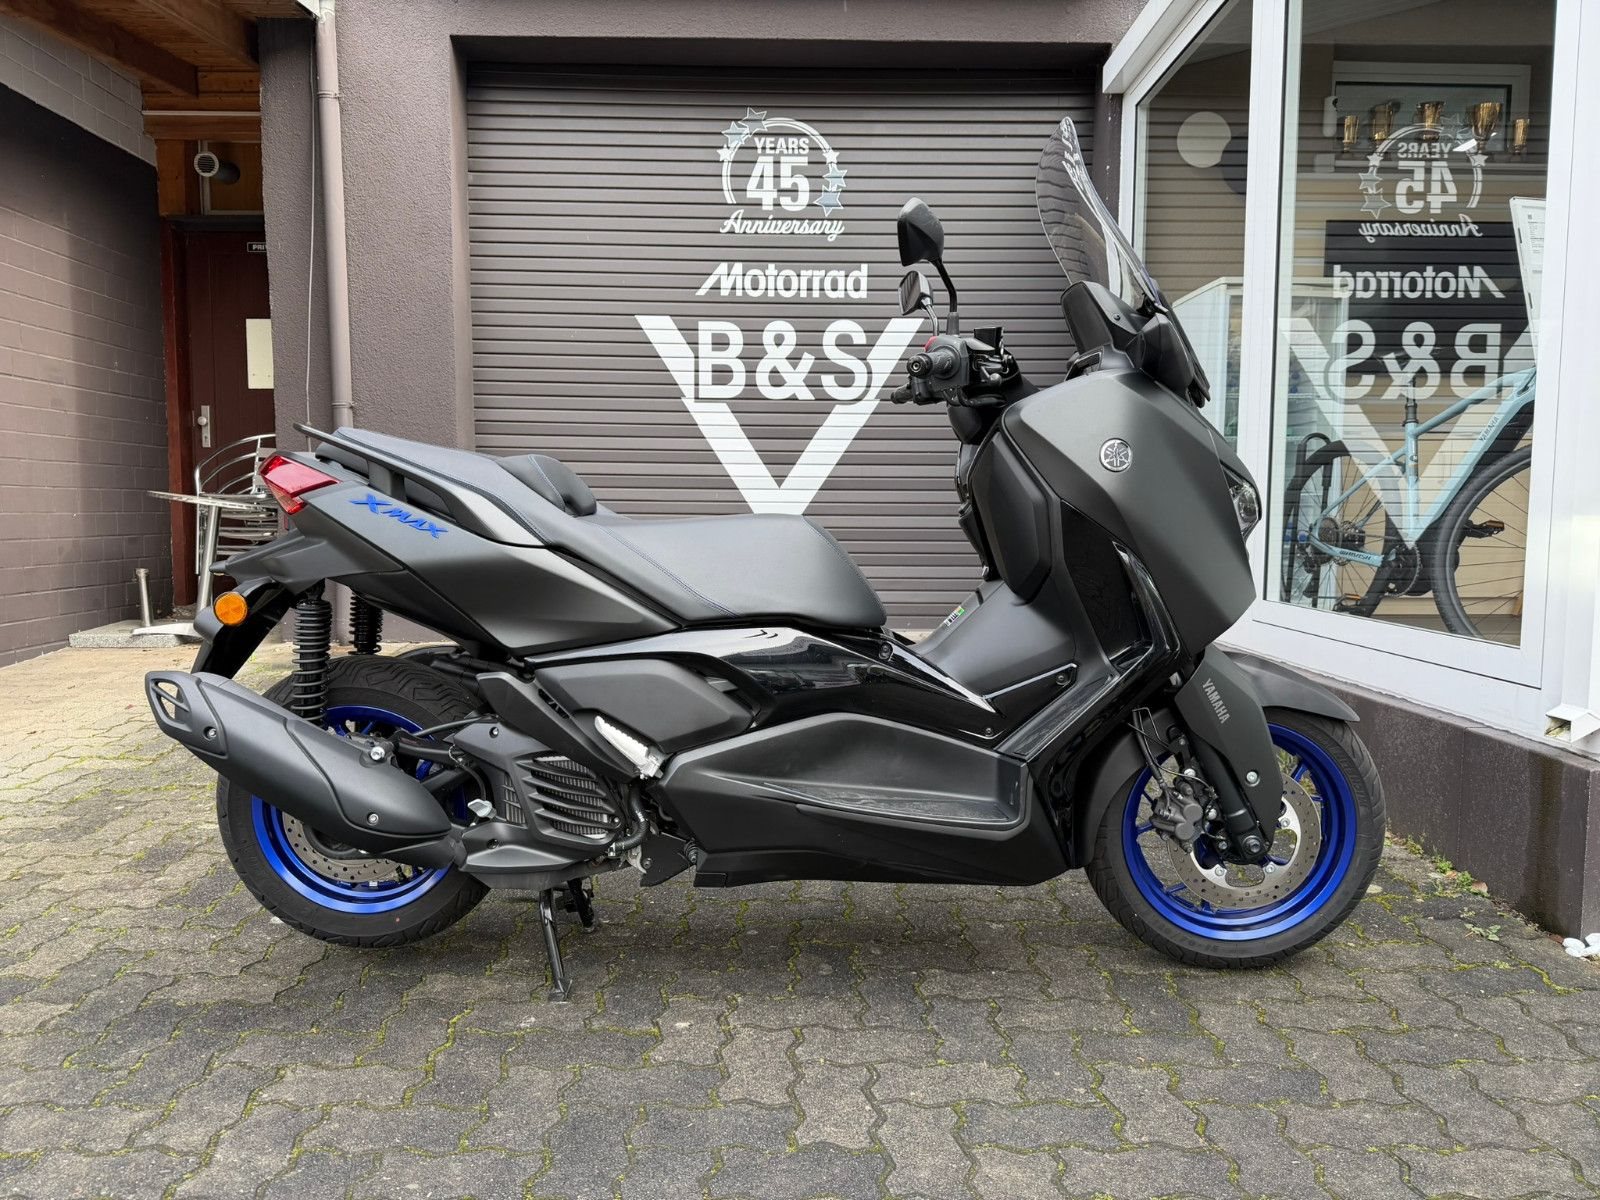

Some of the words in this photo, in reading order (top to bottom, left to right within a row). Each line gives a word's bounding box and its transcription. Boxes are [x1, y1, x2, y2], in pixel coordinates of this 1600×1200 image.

[754, 137, 810, 155] YEARS
[746, 156, 811, 212] 45
[719, 209, 845, 242] Anniversary
[695, 262, 868, 299] Motorrad
[697, 319, 868, 401] B&S
[1202, 677, 1231, 724] YAMAHA
